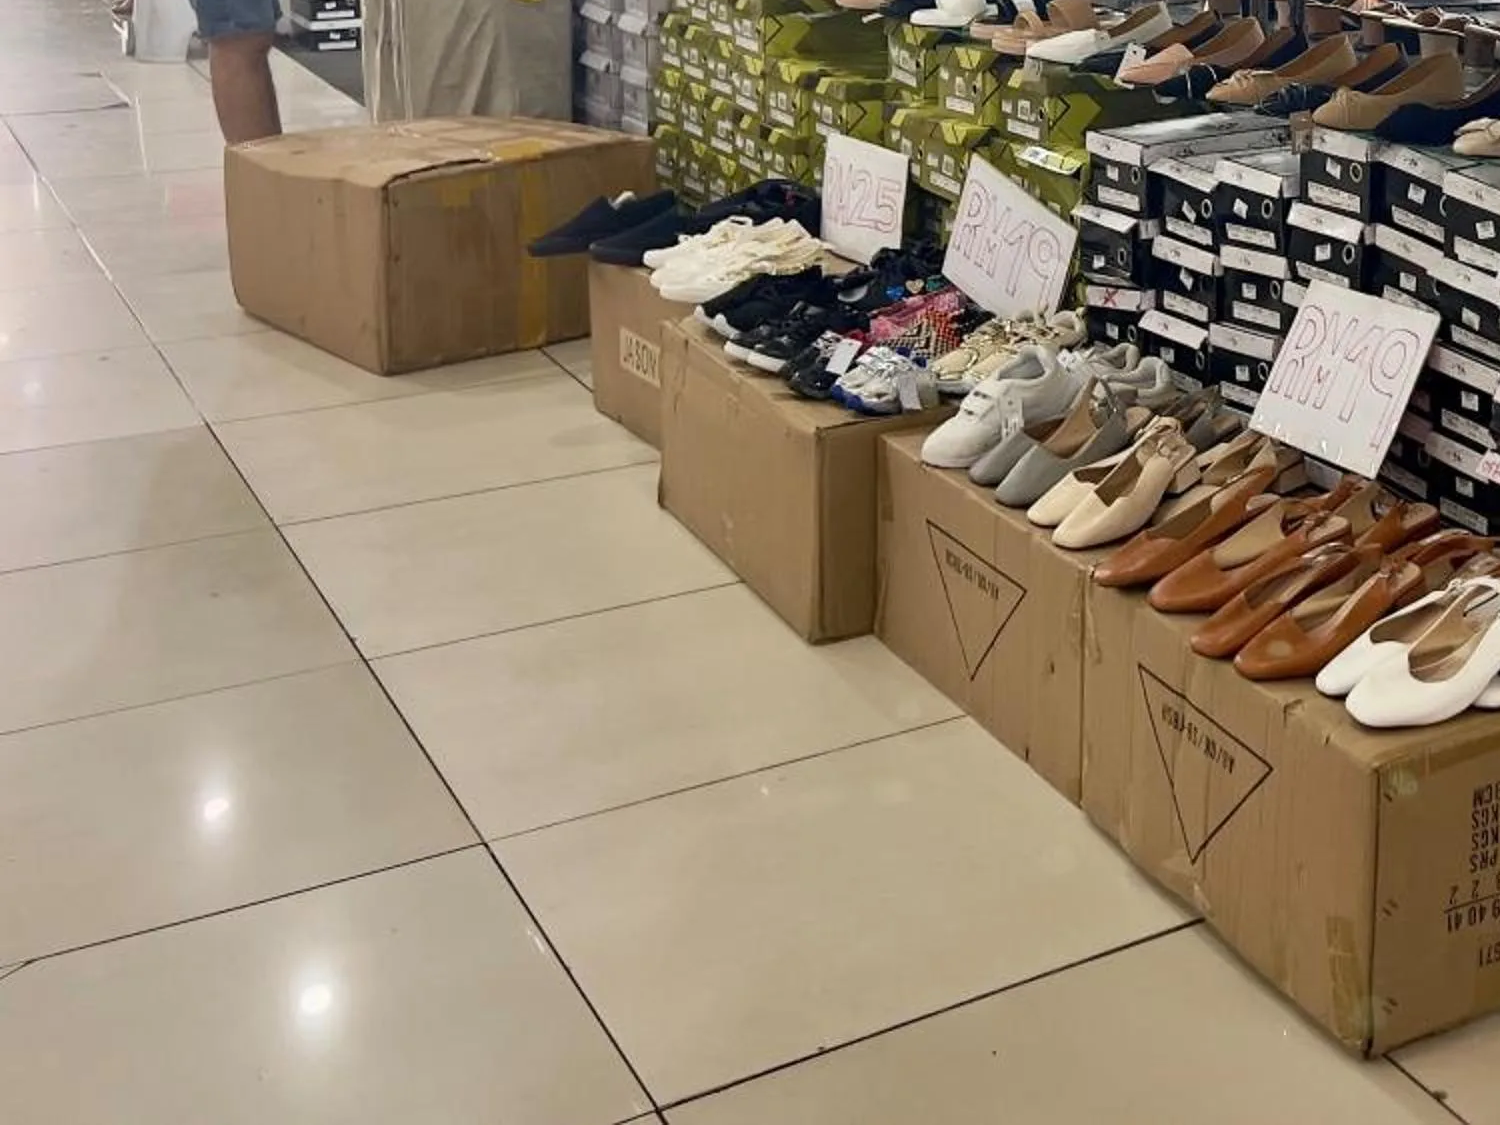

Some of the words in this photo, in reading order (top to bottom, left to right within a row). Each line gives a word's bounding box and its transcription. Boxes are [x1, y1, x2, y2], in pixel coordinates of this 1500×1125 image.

[1269, 304, 1421, 453] RM19
[1471, 802, 1499, 829] KGS
[1471, 826, 1499, 852] KGS
[1469, 846, 1499, 874] PRS
[1449, 885, 1459, 906] 2
[1471, 879, 1481, 899] 2
[1446, 910, 1463, 934] 41
[1468, 903, 1487, 927] 40
